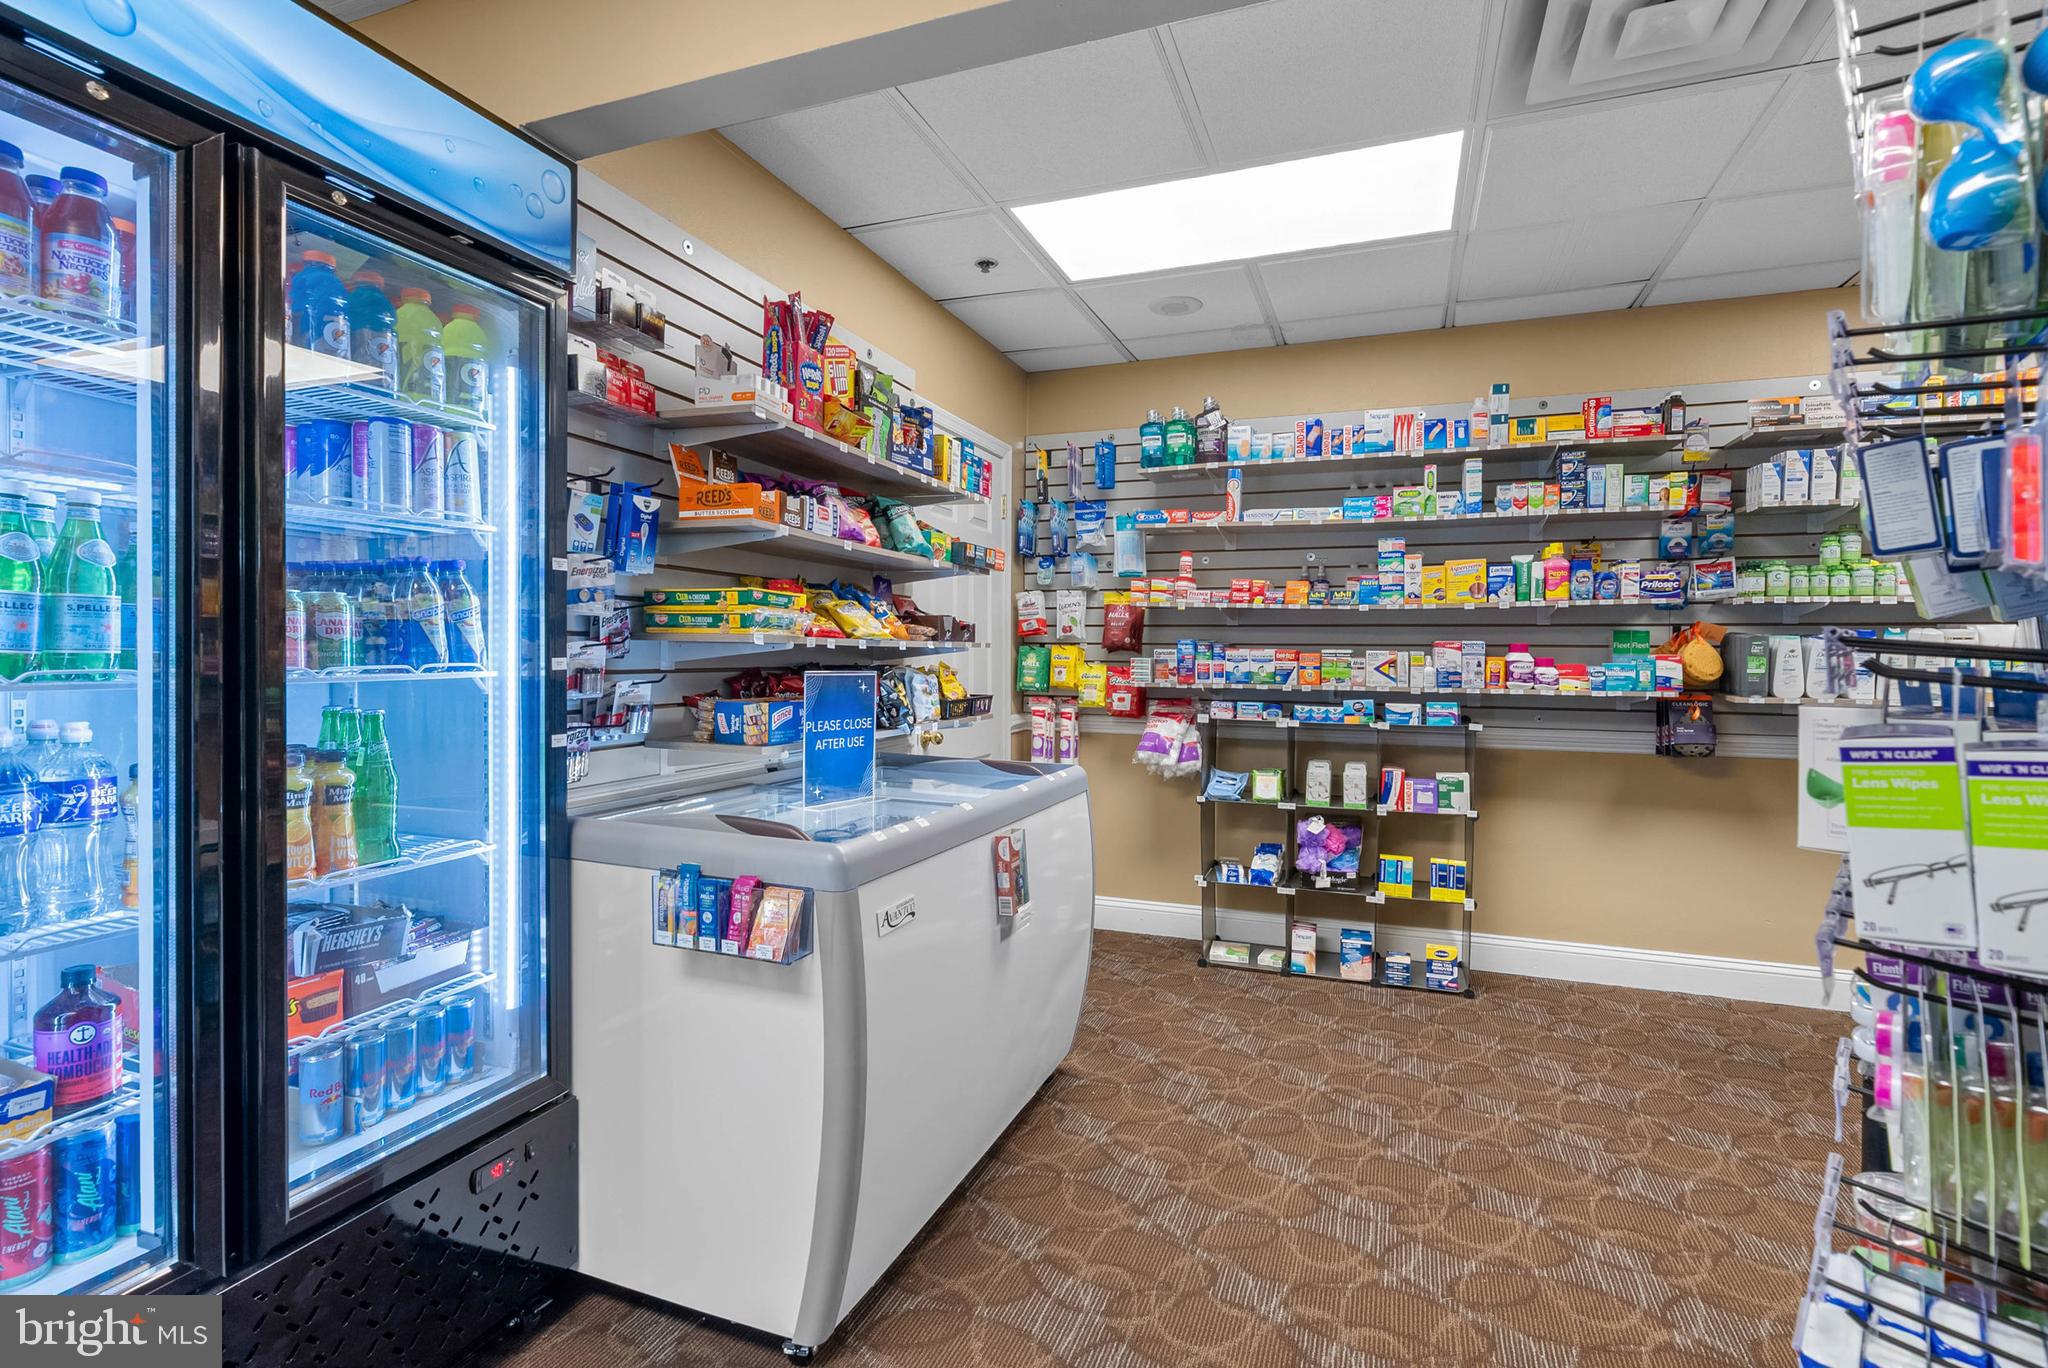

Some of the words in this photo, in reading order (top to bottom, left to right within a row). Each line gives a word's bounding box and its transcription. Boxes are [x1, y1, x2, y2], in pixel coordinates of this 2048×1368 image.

[1296, 420, 1305, 456] BAND-AID
[696, 488, 733, 507] REED'S
[694, 509, 714, 517] BUTTER
[571, 566, 607, 578] Energizer
[1548, 569, 1568, 578] Pepto
[1640, 580, 1680, 590] Prilosec
[1310, 591, 1326, 599] Advil
[1108, 611, 1130, 619] HALLS
[1613, 641, 1630, 649] Fleet
[1631, 641, 1649, 650] Fleet
[772, 708, 792, 725] Lance
[806, 719, 841, 733] PLEASE
[843, 717, 873, 730] CLOSE
[815, 738, 845, 751] AFTER
[847, 736, 866, 749] USE
[1850, 750, 1878, 760] WIPE
[1978, 764, 2009, 774] WIPE
[1851, 777, 1888, 789] Lens
[1890, 778, 1939, 791] Wipes
[1980, 793, 2022, 806] Lens
[1862, 920, 1878, 933] 20
[322, 924, 385, 954] HERSHEY'S
[1988, 948, 2004, 961] 20
[1872, 961, 1900, 974] Flent
[309, 1083, 334, 1099] Red
[74, 1170, 104, 1212] Alani
